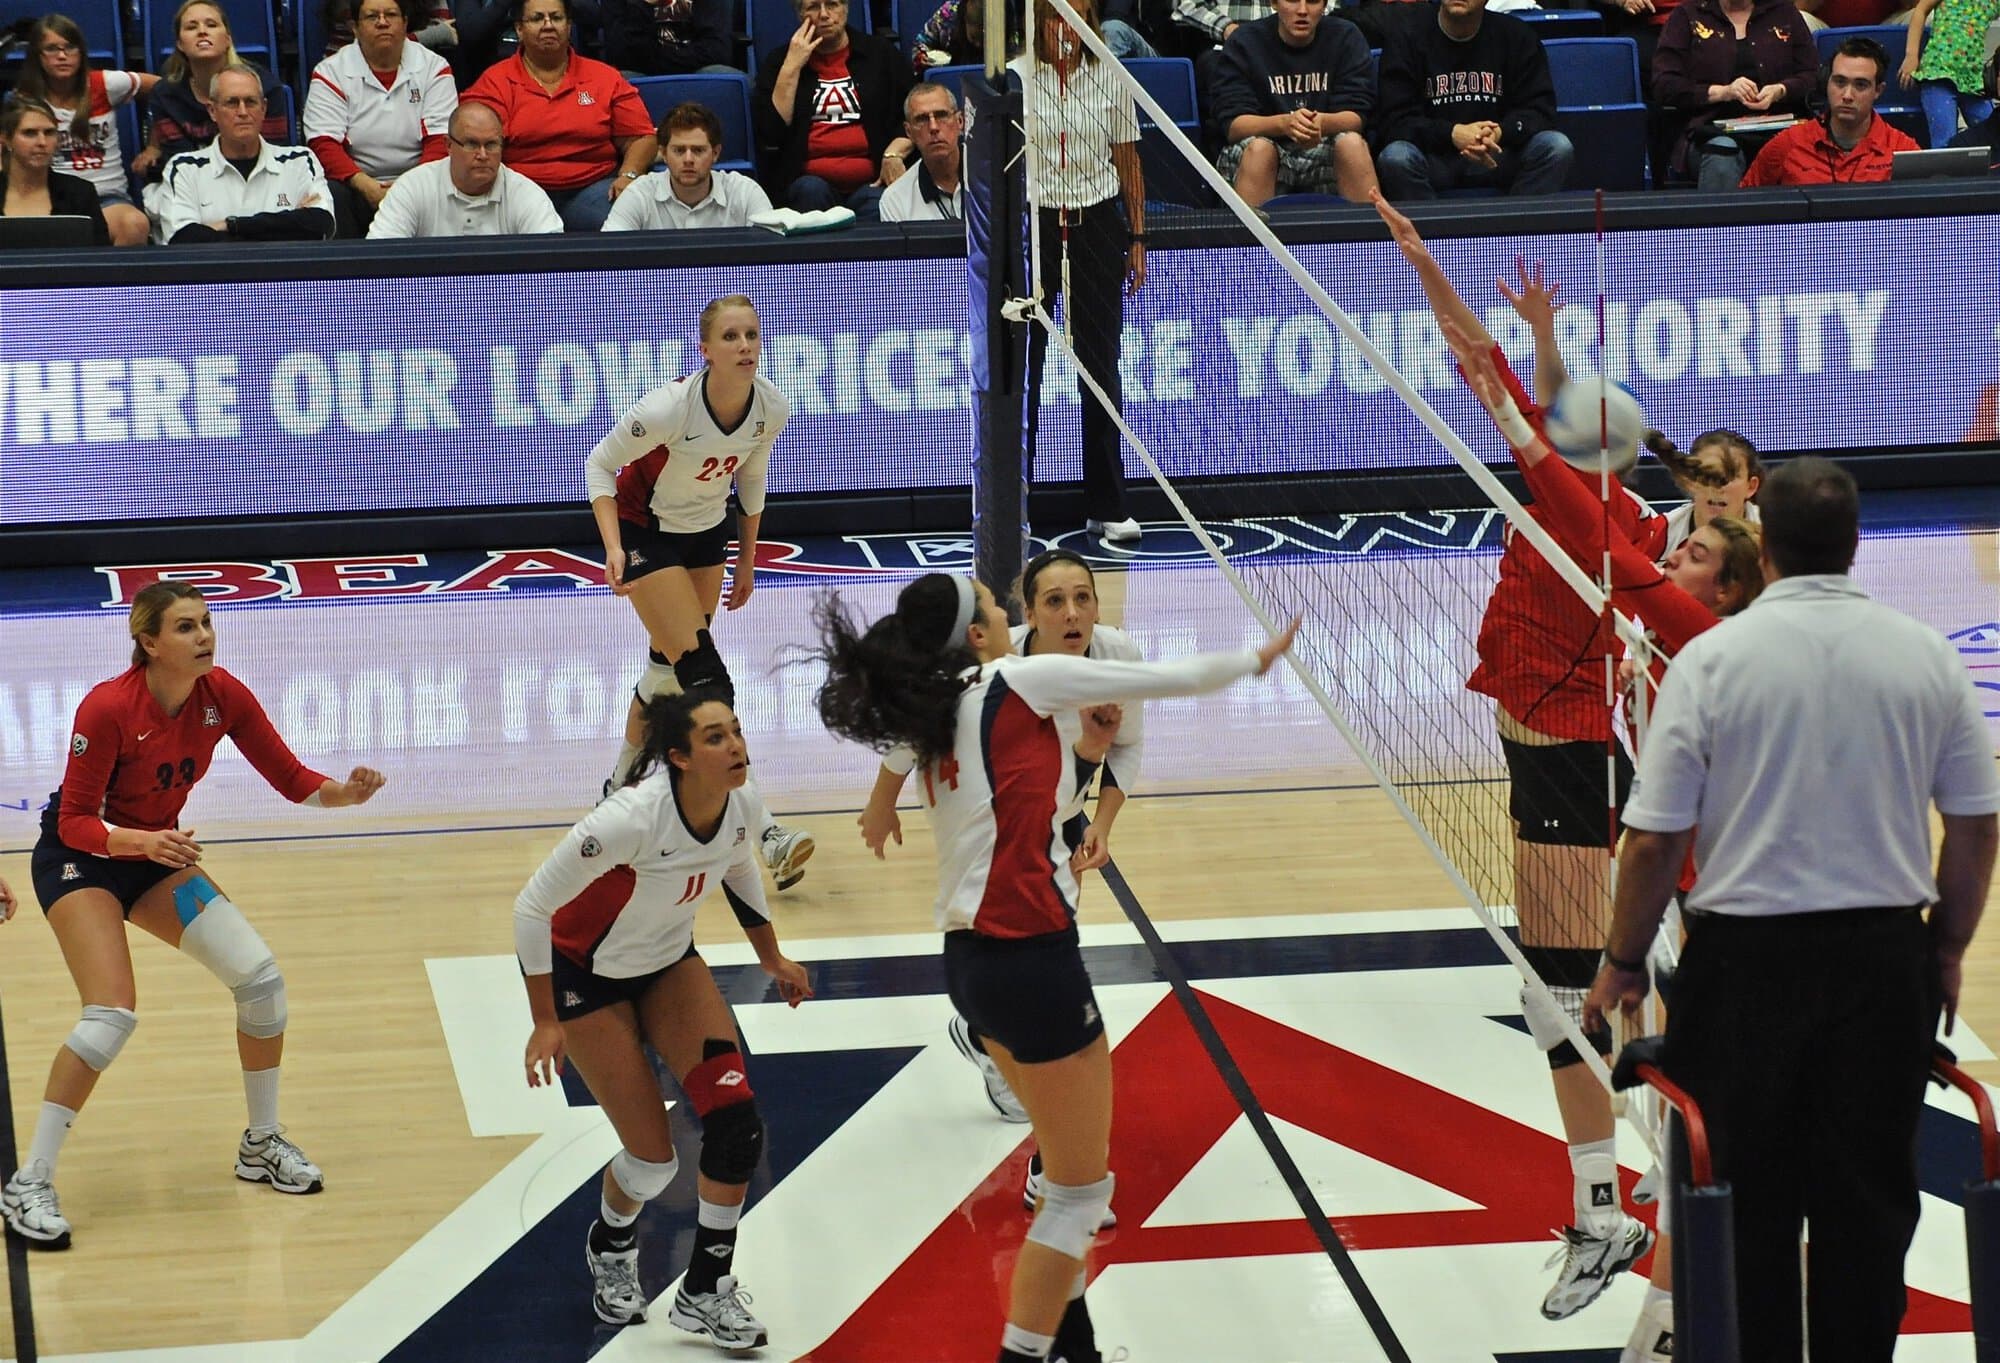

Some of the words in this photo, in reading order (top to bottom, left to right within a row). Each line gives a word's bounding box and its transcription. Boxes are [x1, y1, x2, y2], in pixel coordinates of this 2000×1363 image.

[1267, 72, 1329, 95] ARIZONA
[1432, 95, 1497, 106] WILDCATS
[0, 356, 242, 444] HERE
[270, 350, 462, 435] OUR
[489, 338, 684, 428] LOW
[757, 328, 971, 415] RICE
[1222, 310, 1456, 399] YOUR
[1483, 289, 1889, 386] PRIORITY
[695, 455, 739, 482] 23
[151, 757, 196, 792] 33
[674, 871, 707, 906] 11
